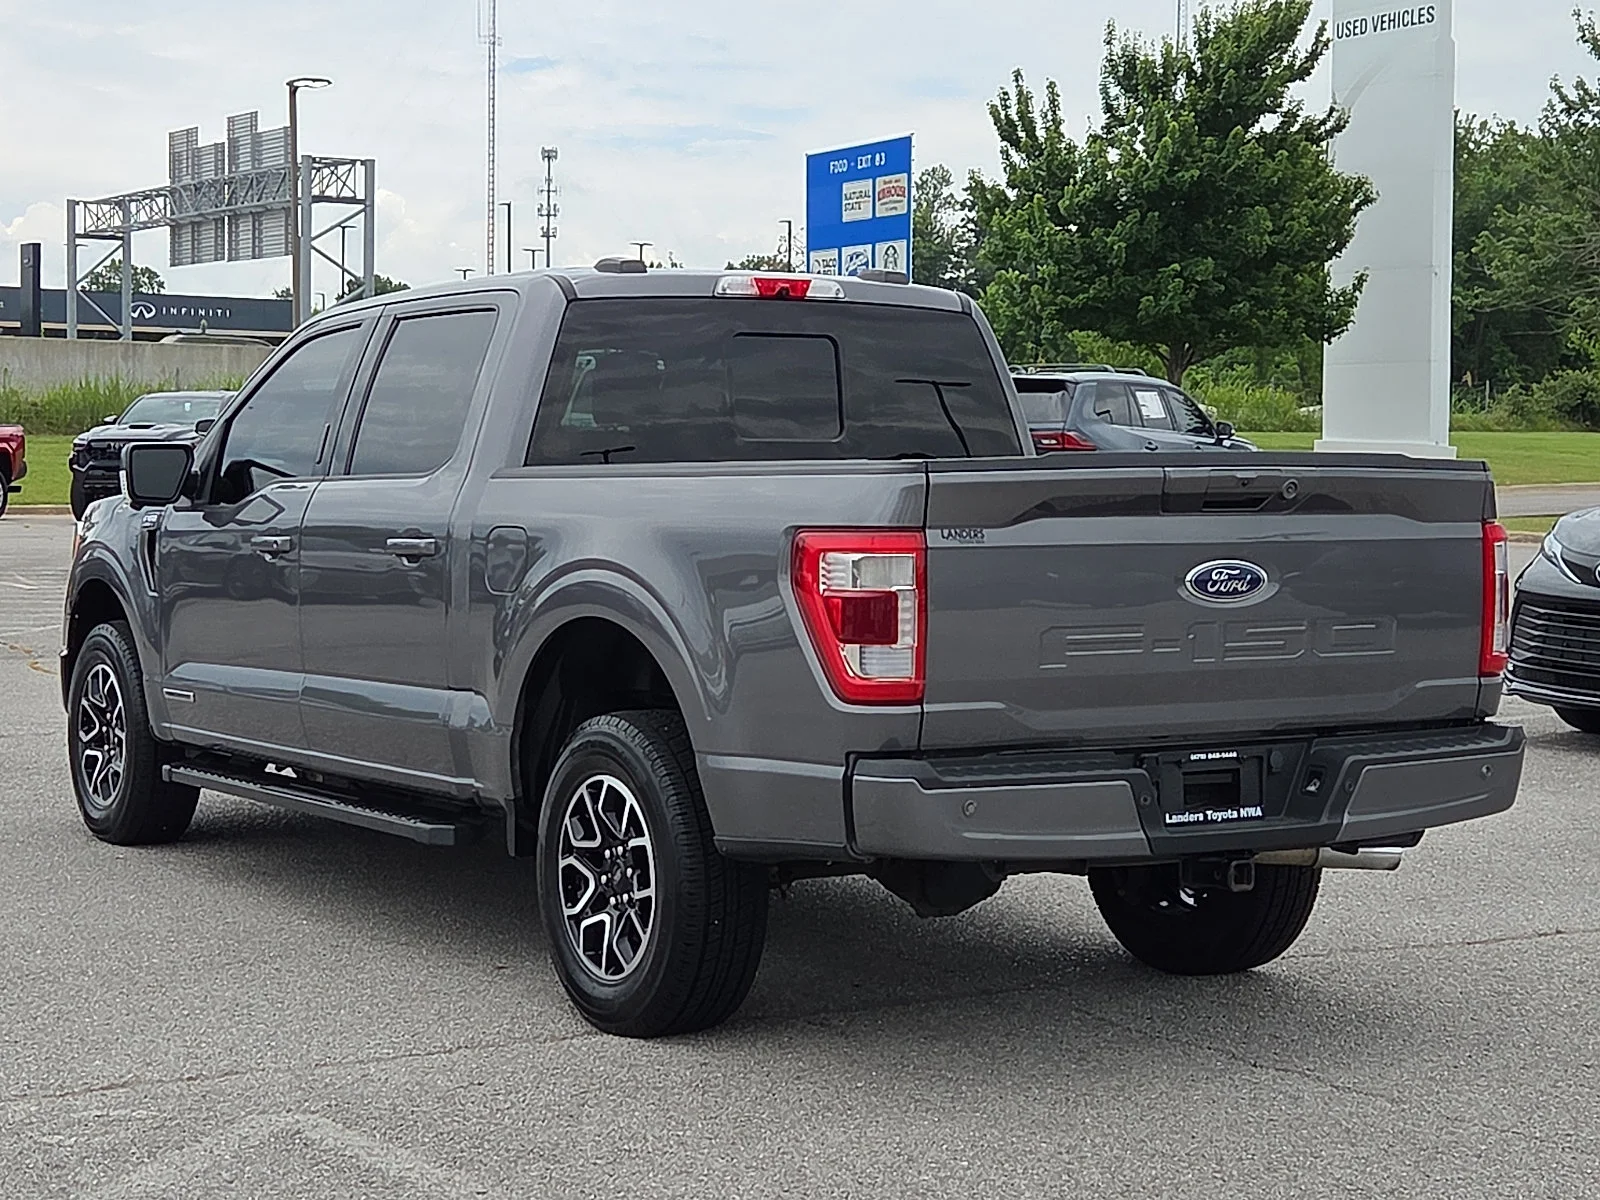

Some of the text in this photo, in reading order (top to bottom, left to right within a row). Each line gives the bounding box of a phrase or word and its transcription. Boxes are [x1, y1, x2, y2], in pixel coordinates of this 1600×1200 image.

[1336, 5, 1435, 40] USED VEHICLES
[829, 159, 848, 174] FOOD
[857, 154, 872, 170] EXIT
[844, 189, 871, 201] NATURAL
[844, 201, 862, 212] STATE
[822, 257, 837, 269] TACO
[162, 306, 231, 318] INFINITI
[1207, 568, 1251, 594] Ford
[1039, 614, 1397, 669] F-150
[1165, 806, 1263, 824] Landers Toyota NWA
